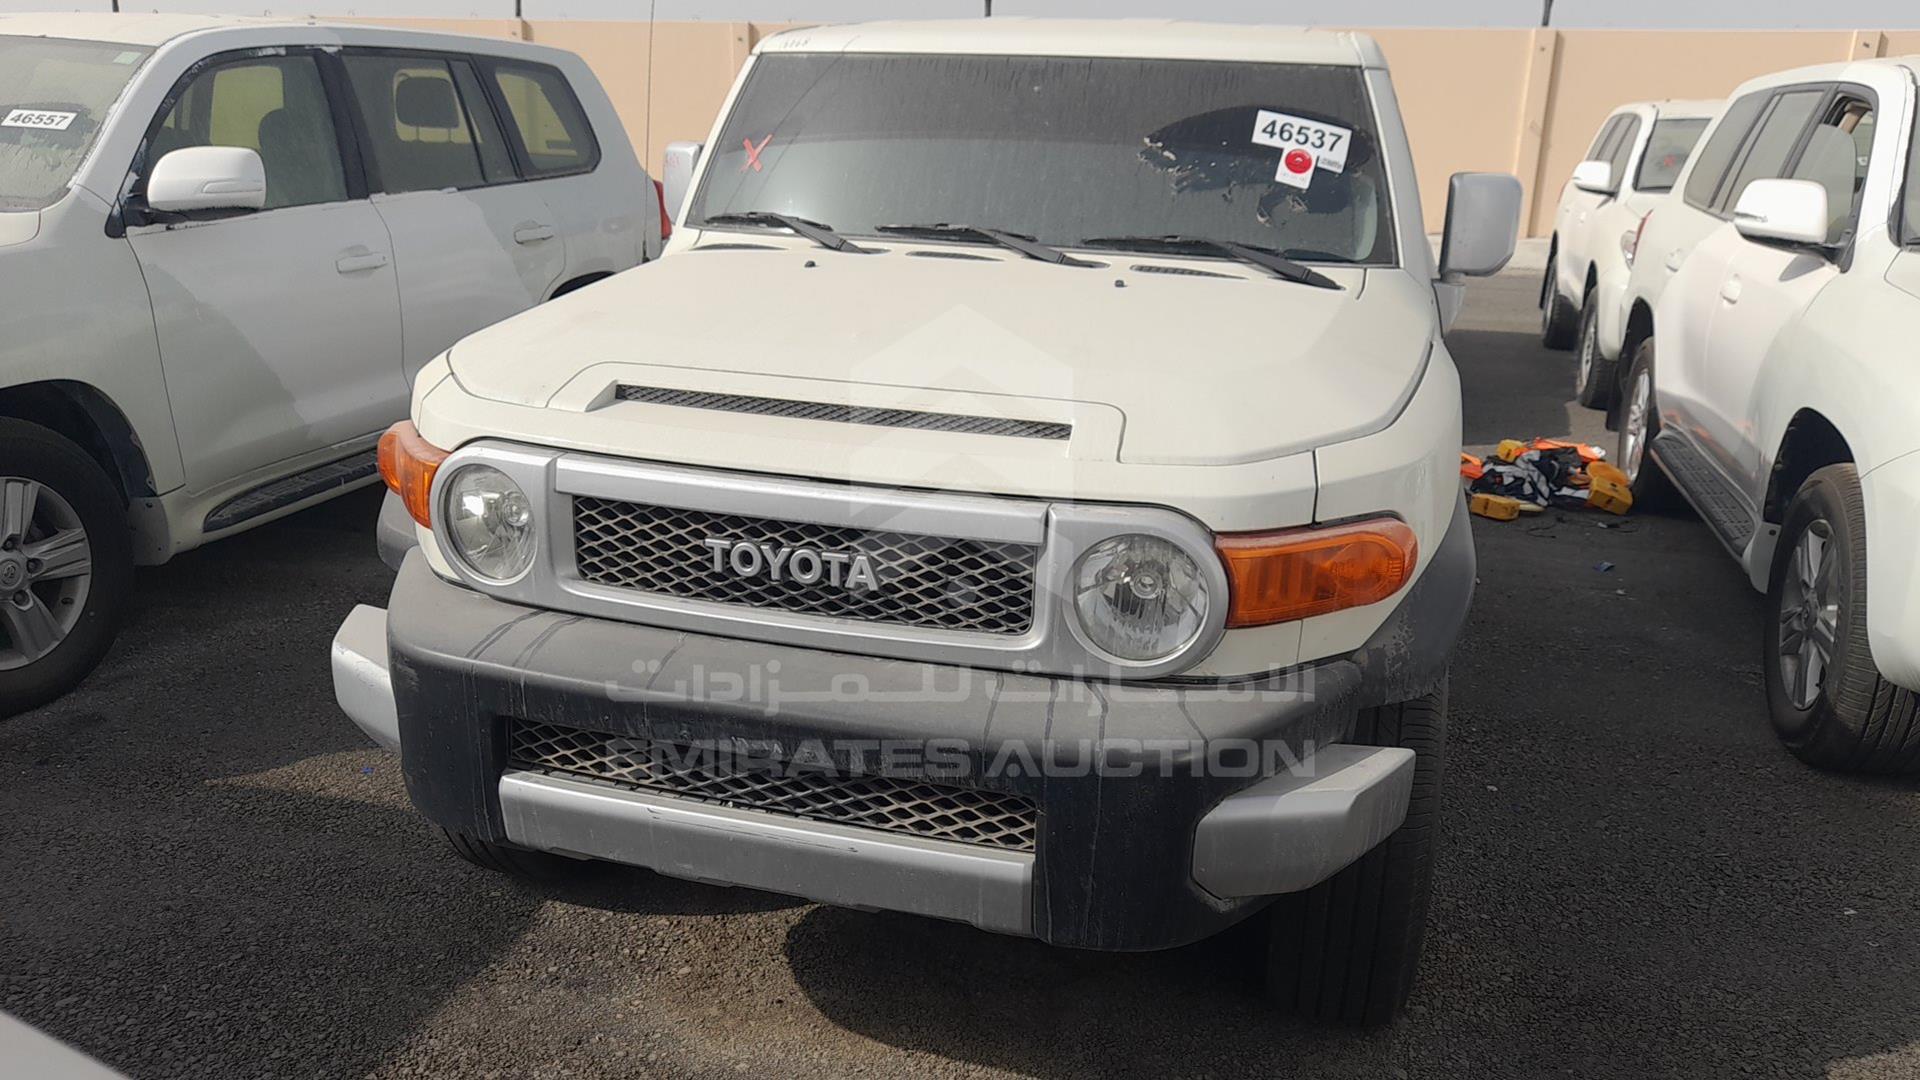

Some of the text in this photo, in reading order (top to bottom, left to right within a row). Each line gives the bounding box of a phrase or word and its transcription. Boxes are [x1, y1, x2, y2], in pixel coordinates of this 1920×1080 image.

[10, 112, 69, 126] 46557
[1261, 119, 1344, 152] 46537
[704, 538, 879, 591] TOYOTA
